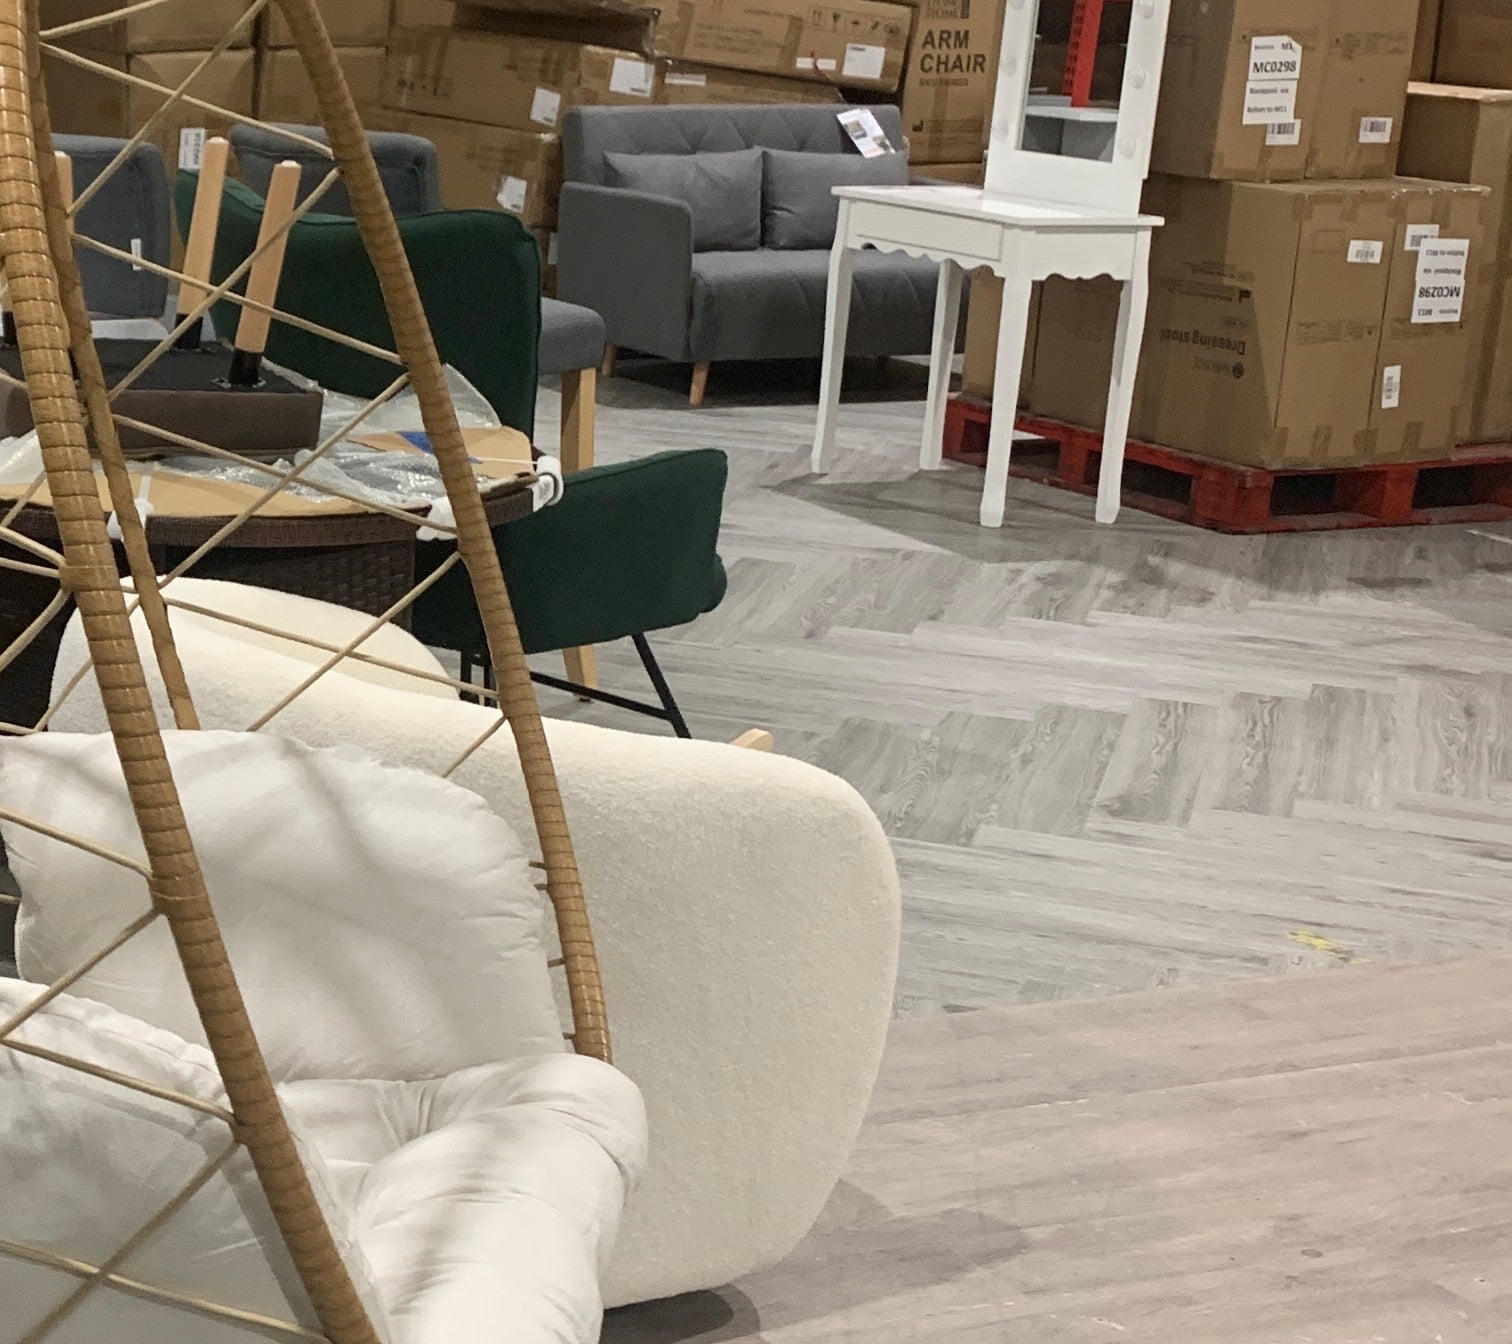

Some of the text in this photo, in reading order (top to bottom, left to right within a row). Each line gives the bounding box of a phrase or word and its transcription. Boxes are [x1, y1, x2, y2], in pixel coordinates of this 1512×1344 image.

[922, 29, 970, 50] ARM
[919, 53, 986, 74] CHAIR
[1252, 60, 1297, 74] MC0298
[1418, 286, 1461, 298] MC0298
